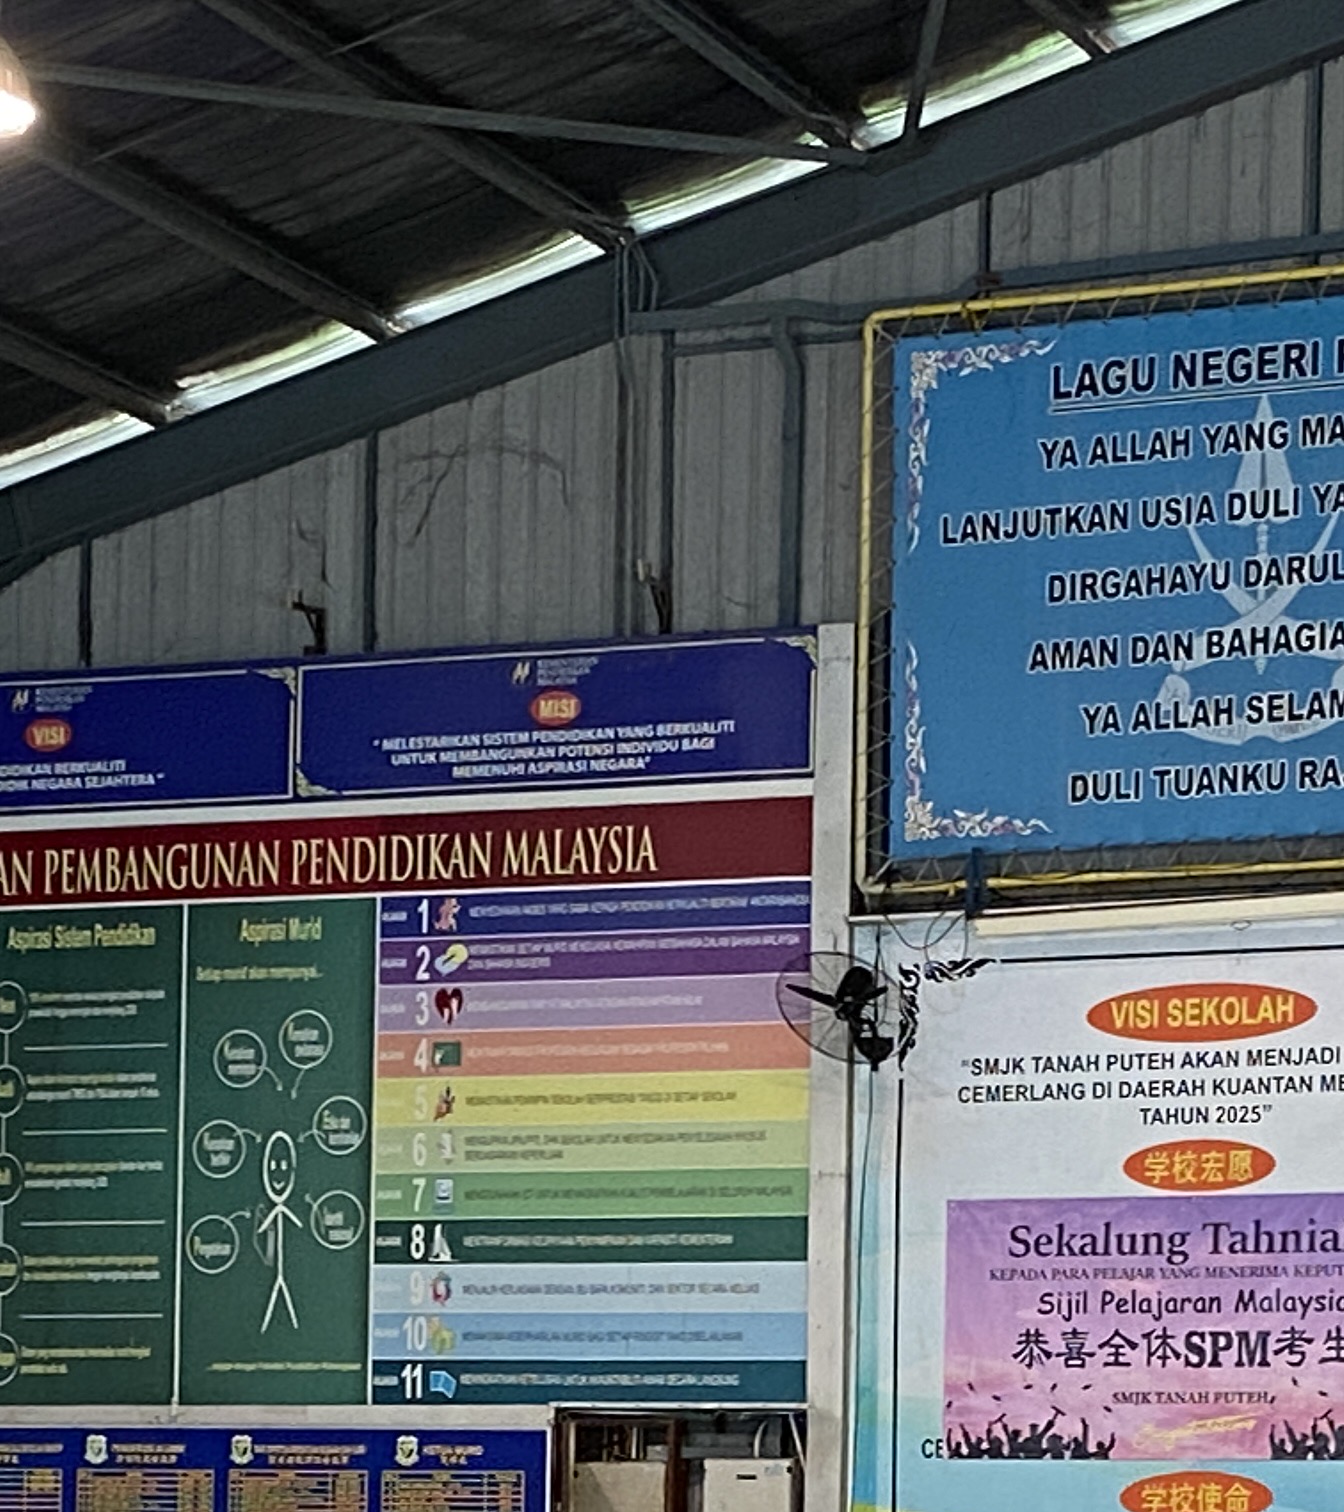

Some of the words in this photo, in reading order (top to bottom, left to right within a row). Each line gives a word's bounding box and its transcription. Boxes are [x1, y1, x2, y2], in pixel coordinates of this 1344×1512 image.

[1052, 355, 1155, 400] LAGU
[1171, 341, 1320, 388] NEGERI
[1040, 438, 1079, 471] YA
[1088, 431, 1189, 467] ALLAH
[1202, 424, 1289, 458] YANG
[941, 505, 1129, 546] LANJUTKAN
[1140, 497, 1216, 530] USIA
[1227, 488, 1302, 522] DULI
[1047, 561, 1234, 605] DIRGAHAYU
[1028, 639, 1121, 673] AMAN
[1131, 632, 1194, 667] DAN
[539, 700, 576, 718] MISI
[1083, 704, 1122, 737] YA
[1131, 696, 1236, 733] ALLAH
[34, 726, 65, 745] VISI
[617, 726, 653, 739] YANG
[656, 721, 735, 736] BERKUALITI
[391, 752, 437, 765] UNTUK
[558, 743, 613, 757] POTENSI
[616, 740, 679, 754] INDIVIDU
[682, 737, 715, 750] BAGI
[1069, 768, 1141, 806] DULI
[1153, 761, 1287, 798] TUANKU
[44, 842, 280, 894] PEMBANGUNAN
[291, 835, 491, 886] PENDIDIKAN
[503, 825, 657, 876] MALAYSIA
[1110, 1002, 1161, 1029] VISI
[1167, 996, 1294, 1025] SEKOLAH
[1031, 1053, 1100, 1074] TANAH
[1105, 1051, 1175, 1072] PUTEH
[1181, 1049, 1240, 1069] AKAN
[1246, 1046, 1342, 1068] MENJADI
[958, 1083, 1086, 1104] CEMERLANG
[1092, 1082, 1113, 1100] DI
[1118, 1078, 1206, 1100] DAERAH
[1211, 1074, 1314, 1096] KUANTAN
[1139, 1106, 1209, 1125] TAHUN
[1142, 1150, 1253, 1184] 学校宏愿
[1008, 1224, 1191, 1264] Sekalung
[989, 1268, 1049, 1282] KEPADA
[1053, 1267, 1088, 1280] PARA
[1093, 1267, 1156, 1281] PELAJAR
[1159, 1266, 1201, 1279] YANG
[1205, 1265, 1290, 1279] MENERIMA
[1038, 1293, 1088, 1322] Sijil
[1101, 1291, 1221, 1321] Pelajaran
[1112, 1392, 1153, 1404] SMJK
[1156, 1391, 1210, 1404] TANAH
[1214, 1391, 1267, 1404] PUTEH
